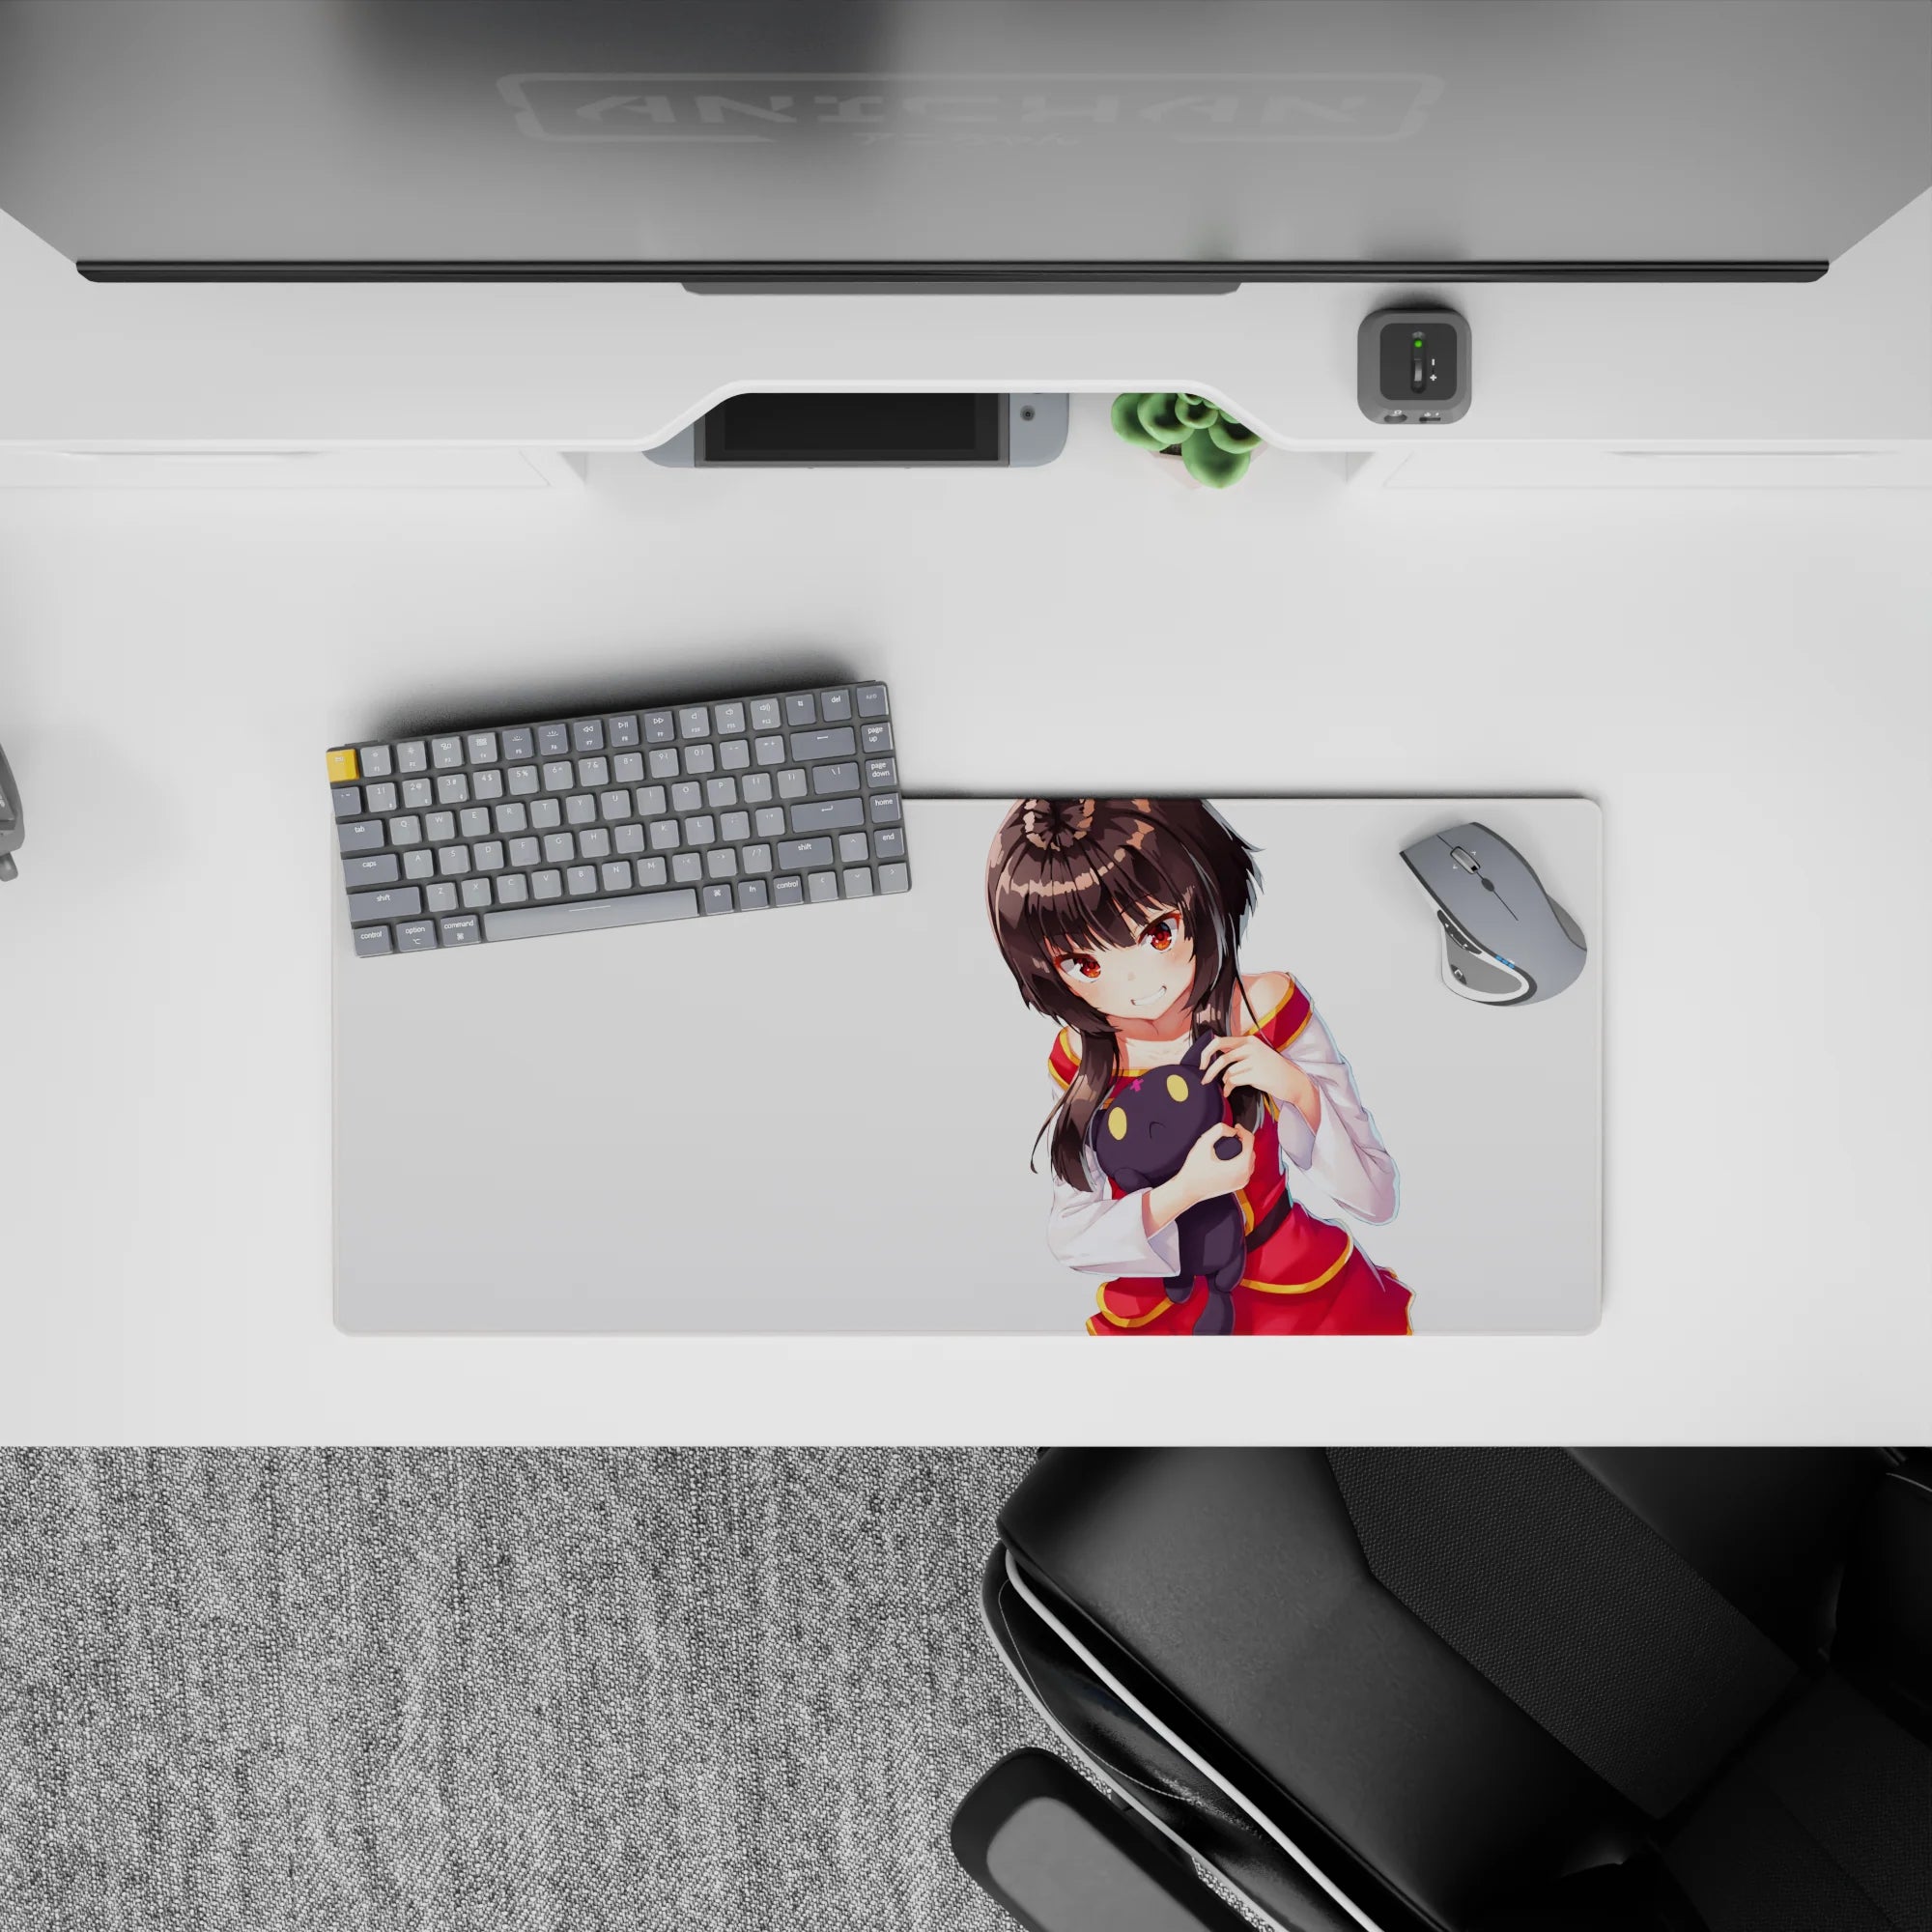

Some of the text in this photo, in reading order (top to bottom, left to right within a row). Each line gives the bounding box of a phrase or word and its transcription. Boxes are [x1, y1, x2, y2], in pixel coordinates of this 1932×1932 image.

[576, 95, 1366, 124] ANICHAN
[872, 769, 891, 778] down
[777, 879, 799, 889] control
[376, 894, 390, 902] shift
[443, 920, 474, 929] command
[360, 930, 383, 940] control
[406, 926, 426, 935] option
